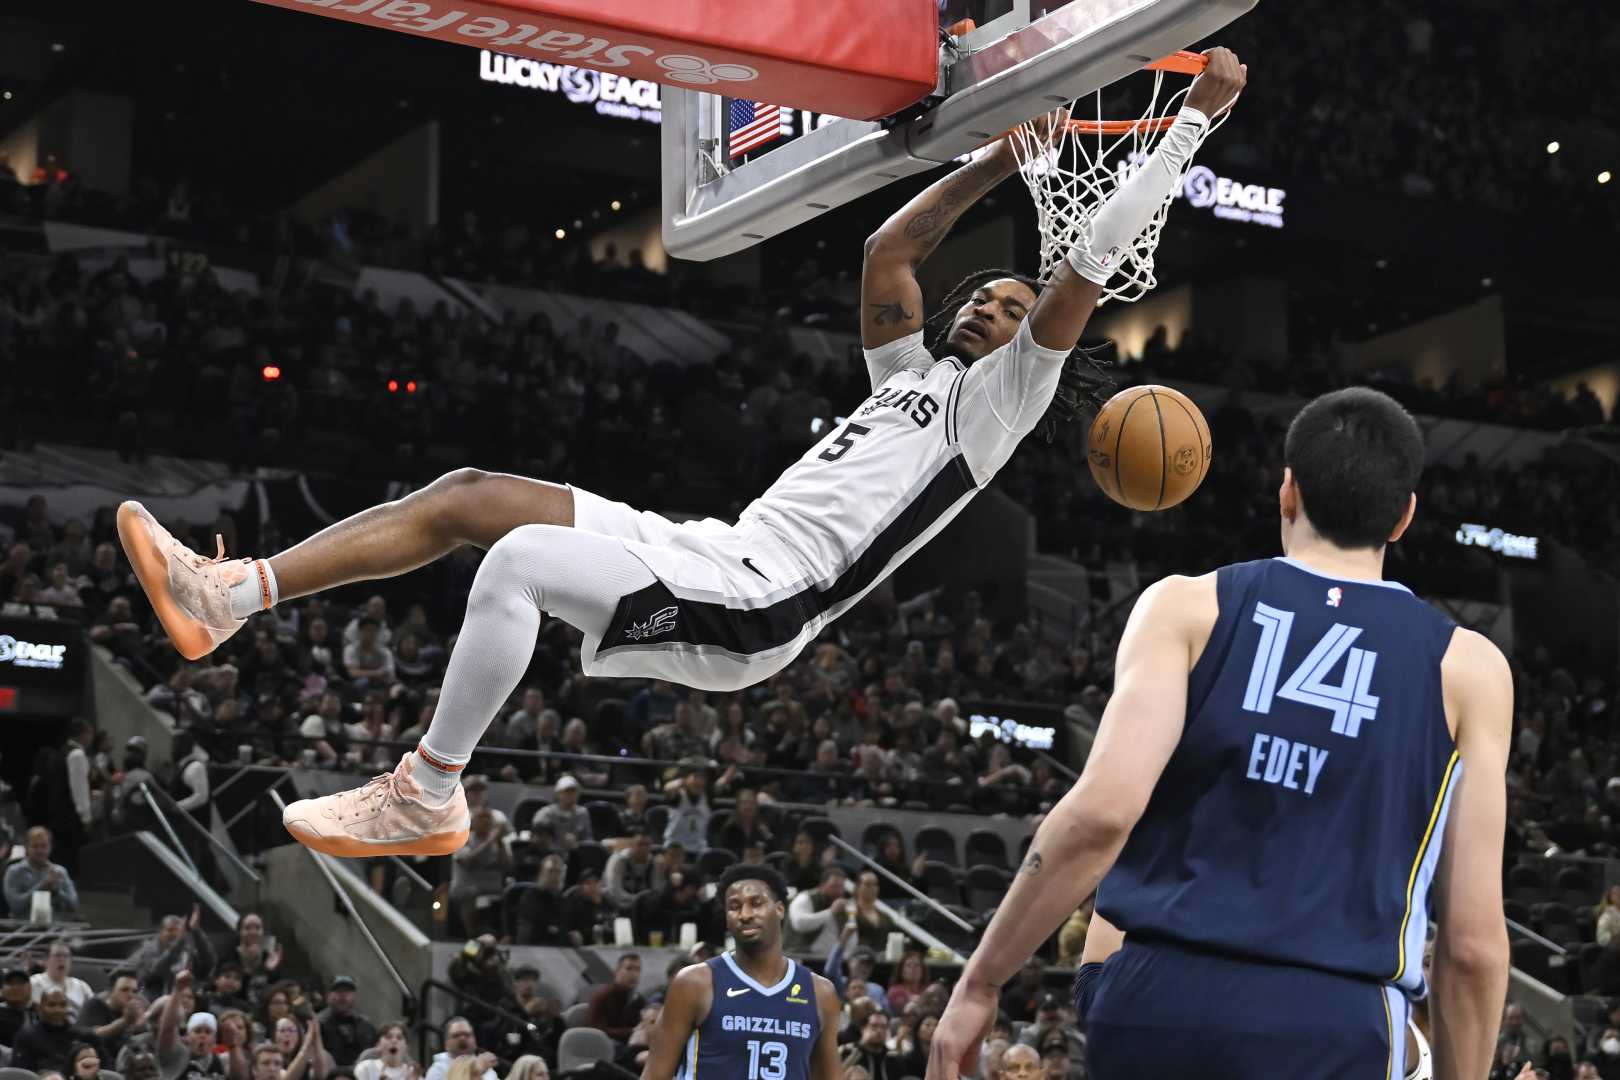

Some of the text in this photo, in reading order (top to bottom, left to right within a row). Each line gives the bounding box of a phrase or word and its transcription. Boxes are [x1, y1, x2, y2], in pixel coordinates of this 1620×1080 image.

[292, 0, 655, 68] StateFar
[480, 50, 661, 109] LUCKY EAGL
[1216, 177, 1286, 214] EAGLE
[818, 423, 871, 462] 5
[1241, 601, 1381, 738] 14
[1246, 732, 1330, 796] EDEY
[721, 1015, 811, 1039] GRIZZLIES
[747, 1040, 788, 1080] 13
